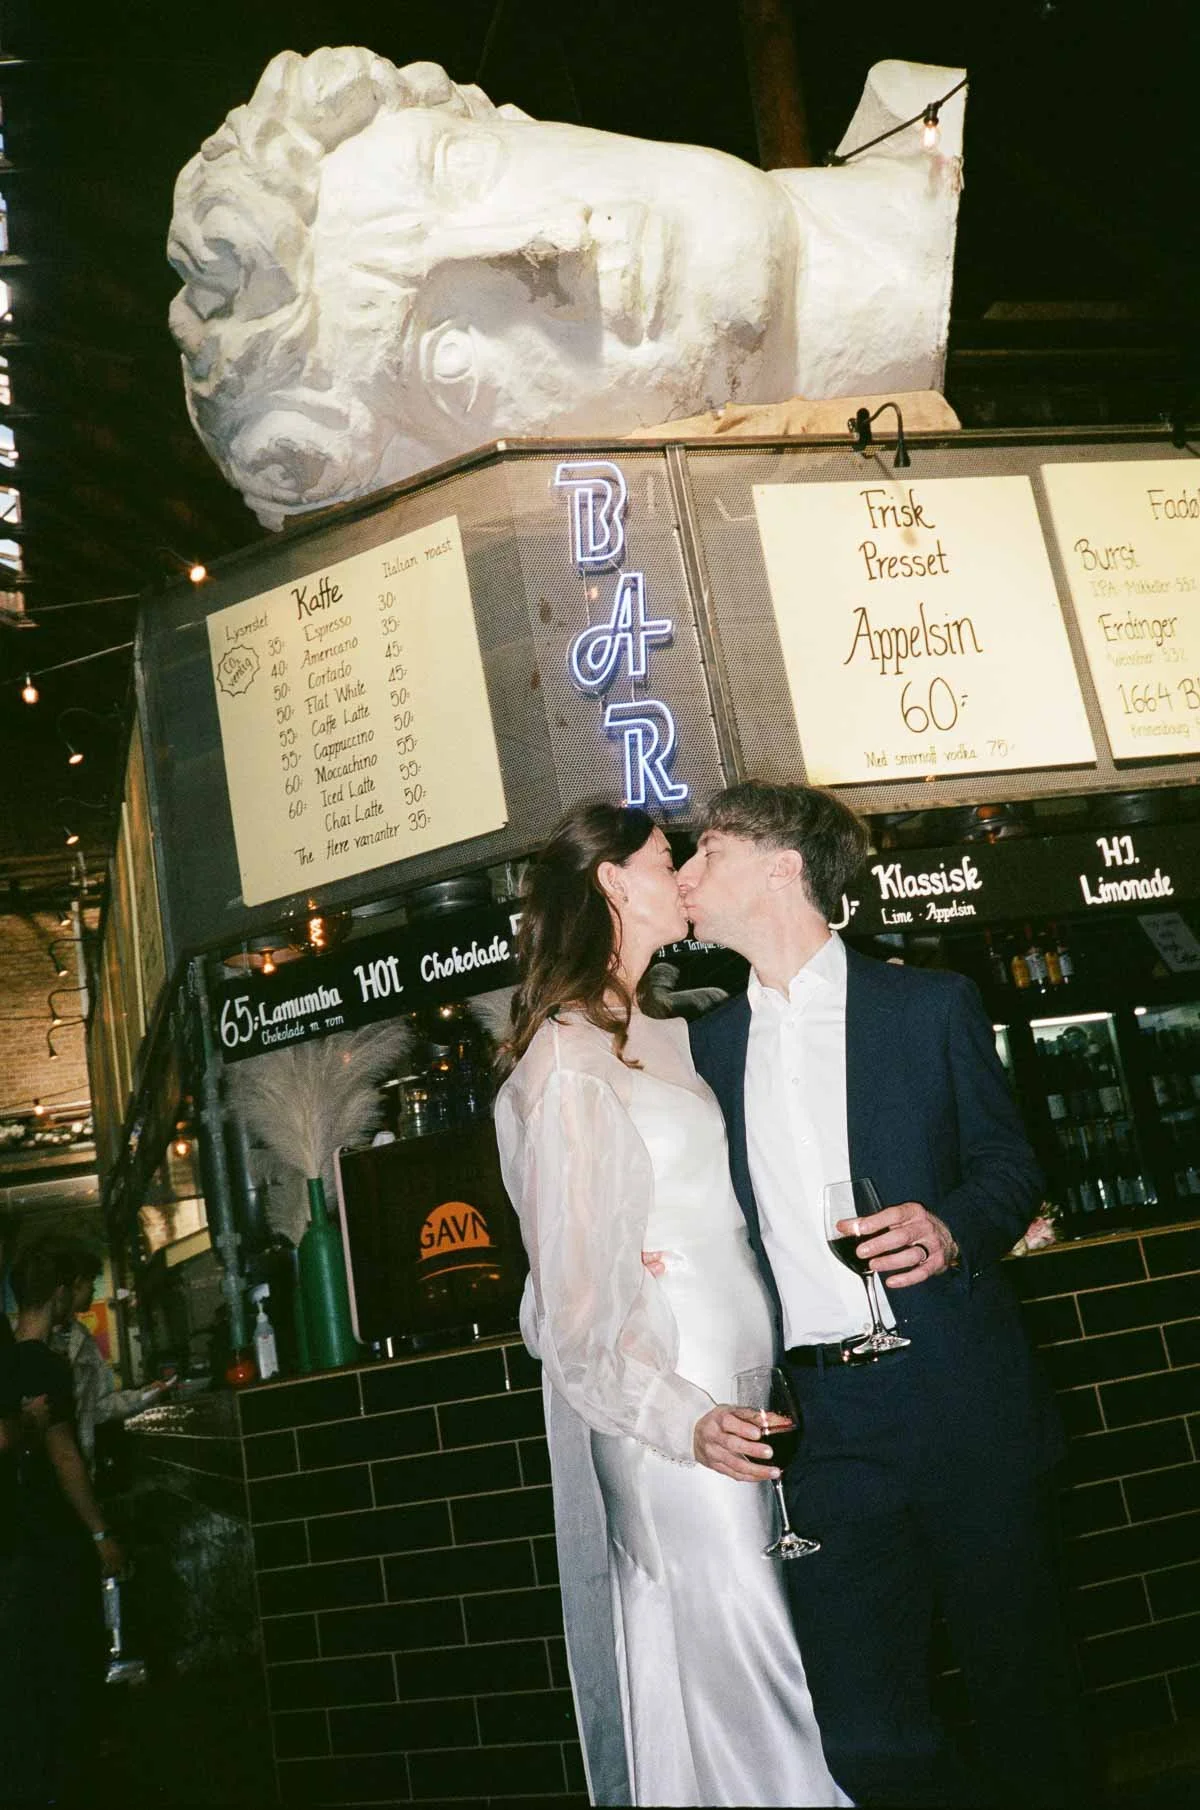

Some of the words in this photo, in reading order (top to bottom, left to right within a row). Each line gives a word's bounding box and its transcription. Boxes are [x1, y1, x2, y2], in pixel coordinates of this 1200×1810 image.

[859, 488, 937, 530] Frisk
[1146, 488, 1200, 520] Fadø
[381, 555, 419, 579] Italian
[423, 537, 453, 561] roast
[858, 539, 950, 581] Presset
[291, 576, 344, 621] Kaffe
[302, 615, 352, 643] Espresso
[554, 460, 689, 806] BAR
[843, 602, 984, 676] Appelsin
[1097, 609, 1178, 647] Erdinger
[300, 637, 359, 670] Americano
[308, 660, 353, 690] Cortado
[303, 692, 329, 715] Flat
[334, 680, 367, 704] White
[1117, 682, 1175, 716] 1664
[1177, 677, 1200, 710] B
[343, 703, 371, 726] Latte
[313, 729, 376, 762] Cappuccino
[943, 743, 977, 761] vodka
[314, 753, 379, 786] Moccachino
[320, 783, 345, 809] Iced
[348, 775, 377, 799] Latte
[325, 811, 352, 833] Chai
[354, 800, 385, 823] Latte
[294, 846, 315, 867] The
[353, 822, 401, 850] varianter
[871, 855, 983, 900] Klassisk
[1079, 867, 1175, 905] Limonade
[880, 907, 914, 925] Lime
[925, 899, 977, 924] Appelsin
[258, 984, 344, 1027] Lamumba
[420, 935, 511, 984] Chokolade
[261, 1021, 306, 1046] Chokolade
[324, 1015, 345, 1028] rom
